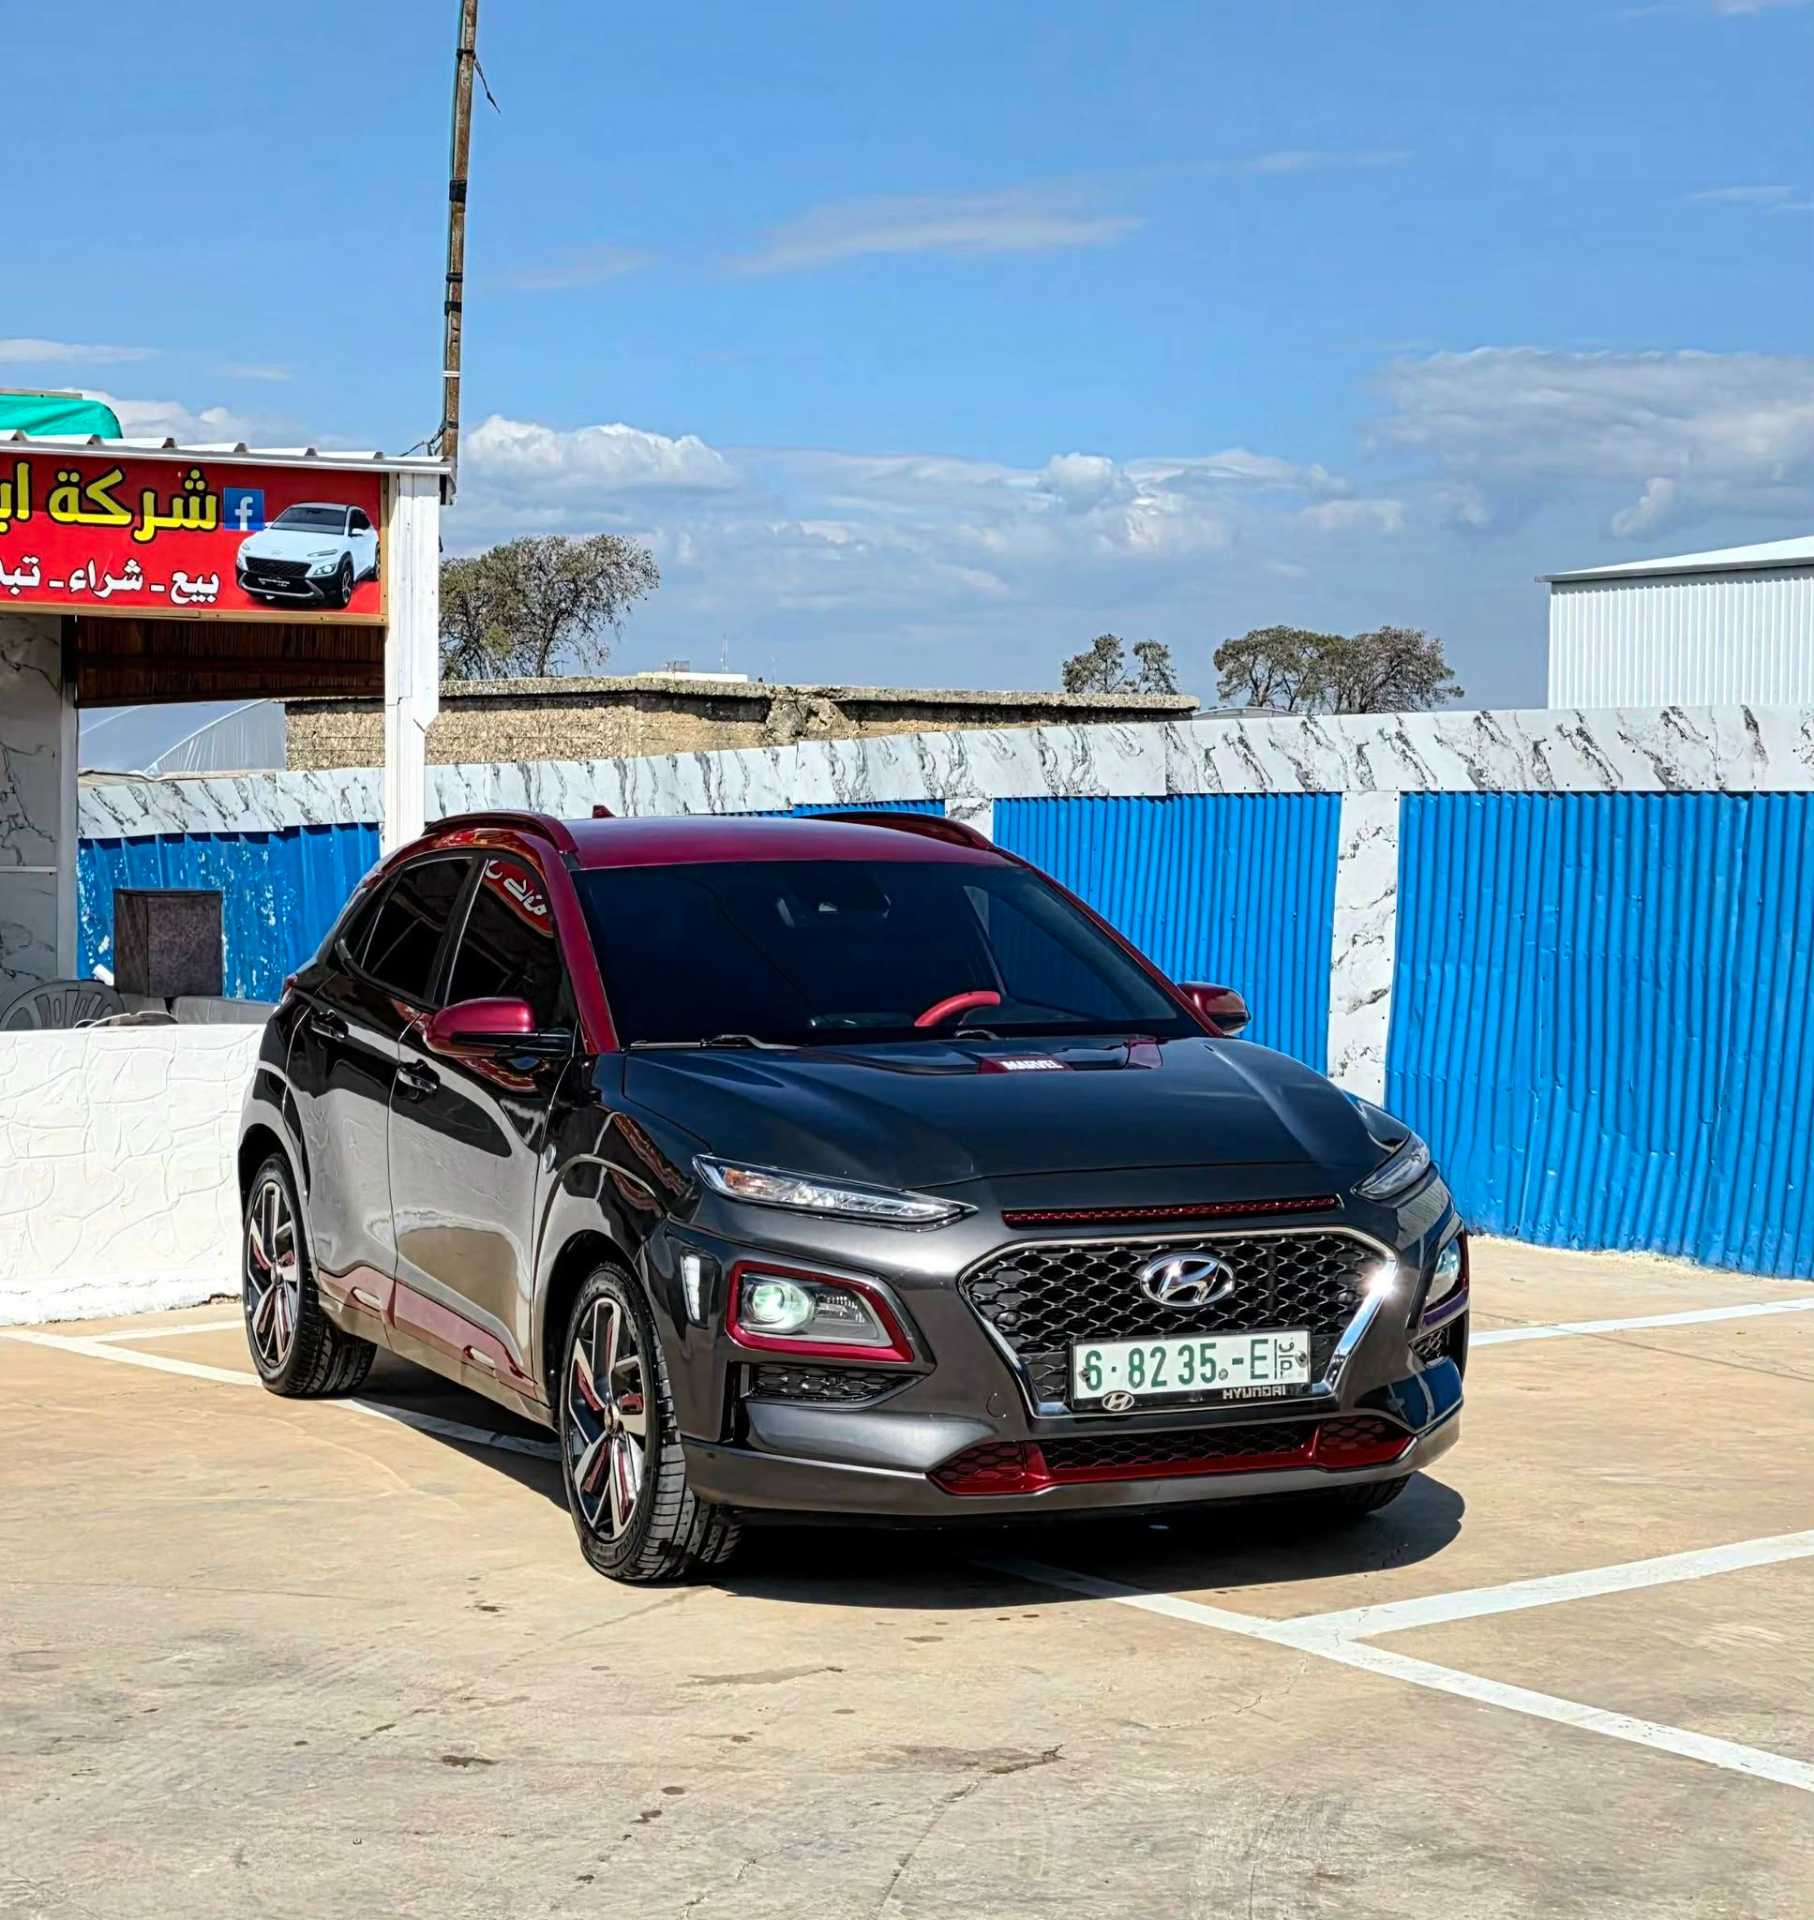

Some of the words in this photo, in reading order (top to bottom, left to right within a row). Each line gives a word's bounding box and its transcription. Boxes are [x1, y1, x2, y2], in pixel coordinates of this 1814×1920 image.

[0, 462, 30, 533] اب
[50, 469, 217, 541] شركة
[0, 555, 41, 595] تبد
[68, 558, 144, 599] شراء
[171, 572, 220, 604] بيع
[1222, 1384, 1287, 1400] HYUNDAI
